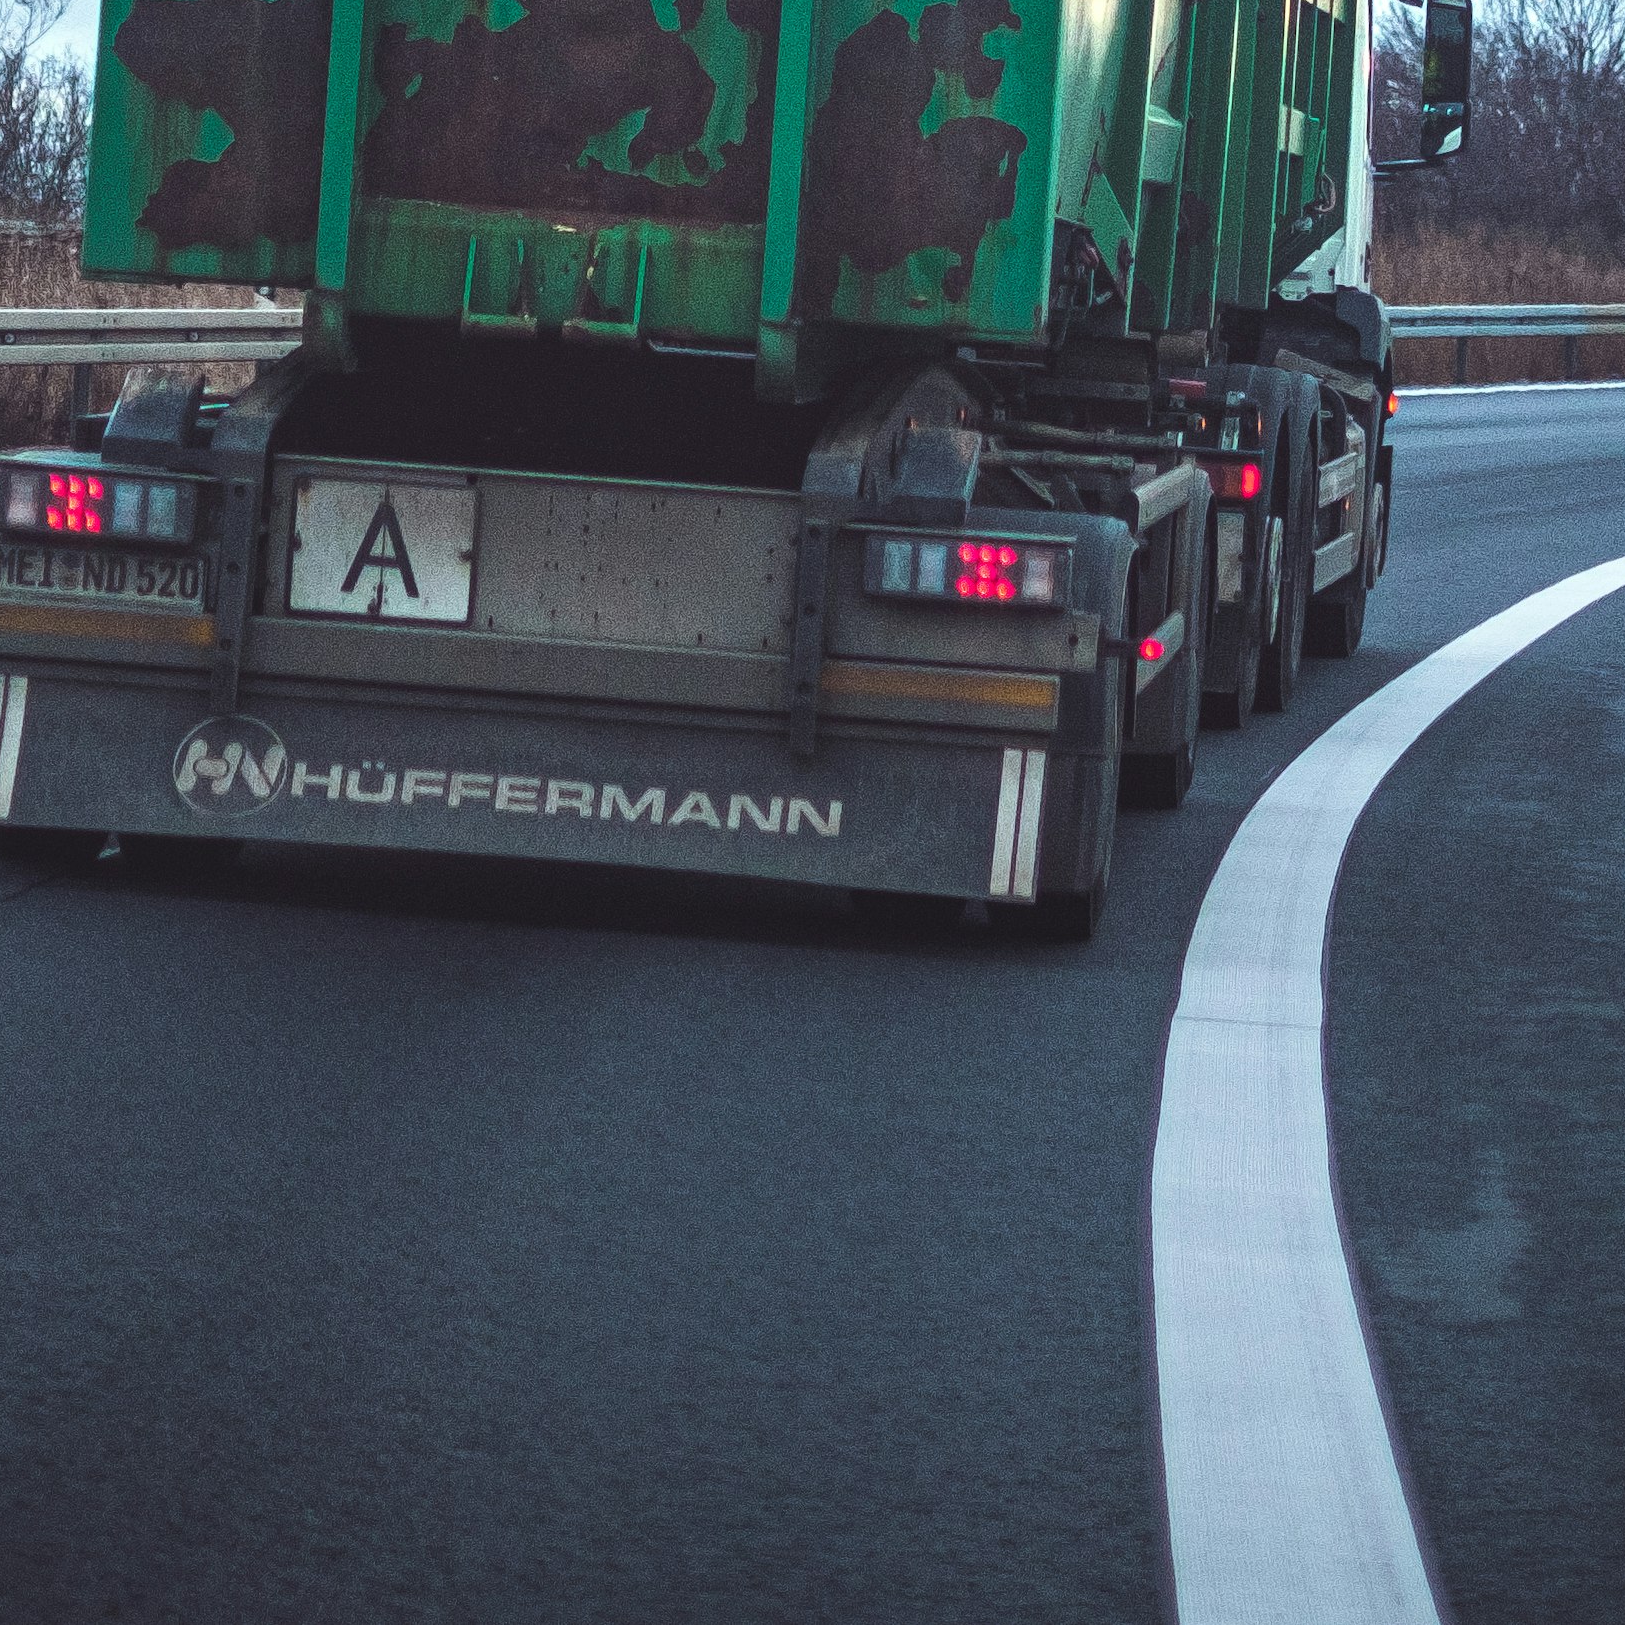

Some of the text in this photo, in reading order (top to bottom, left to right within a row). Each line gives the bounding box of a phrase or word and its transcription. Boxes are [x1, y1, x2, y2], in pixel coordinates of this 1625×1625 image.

[82, 553, 127, 594] ND
[135, 560, 199, 600] 520
[340, 500, 420, 599] A
[291, 759, 844, 837] HÜFFERMANN
